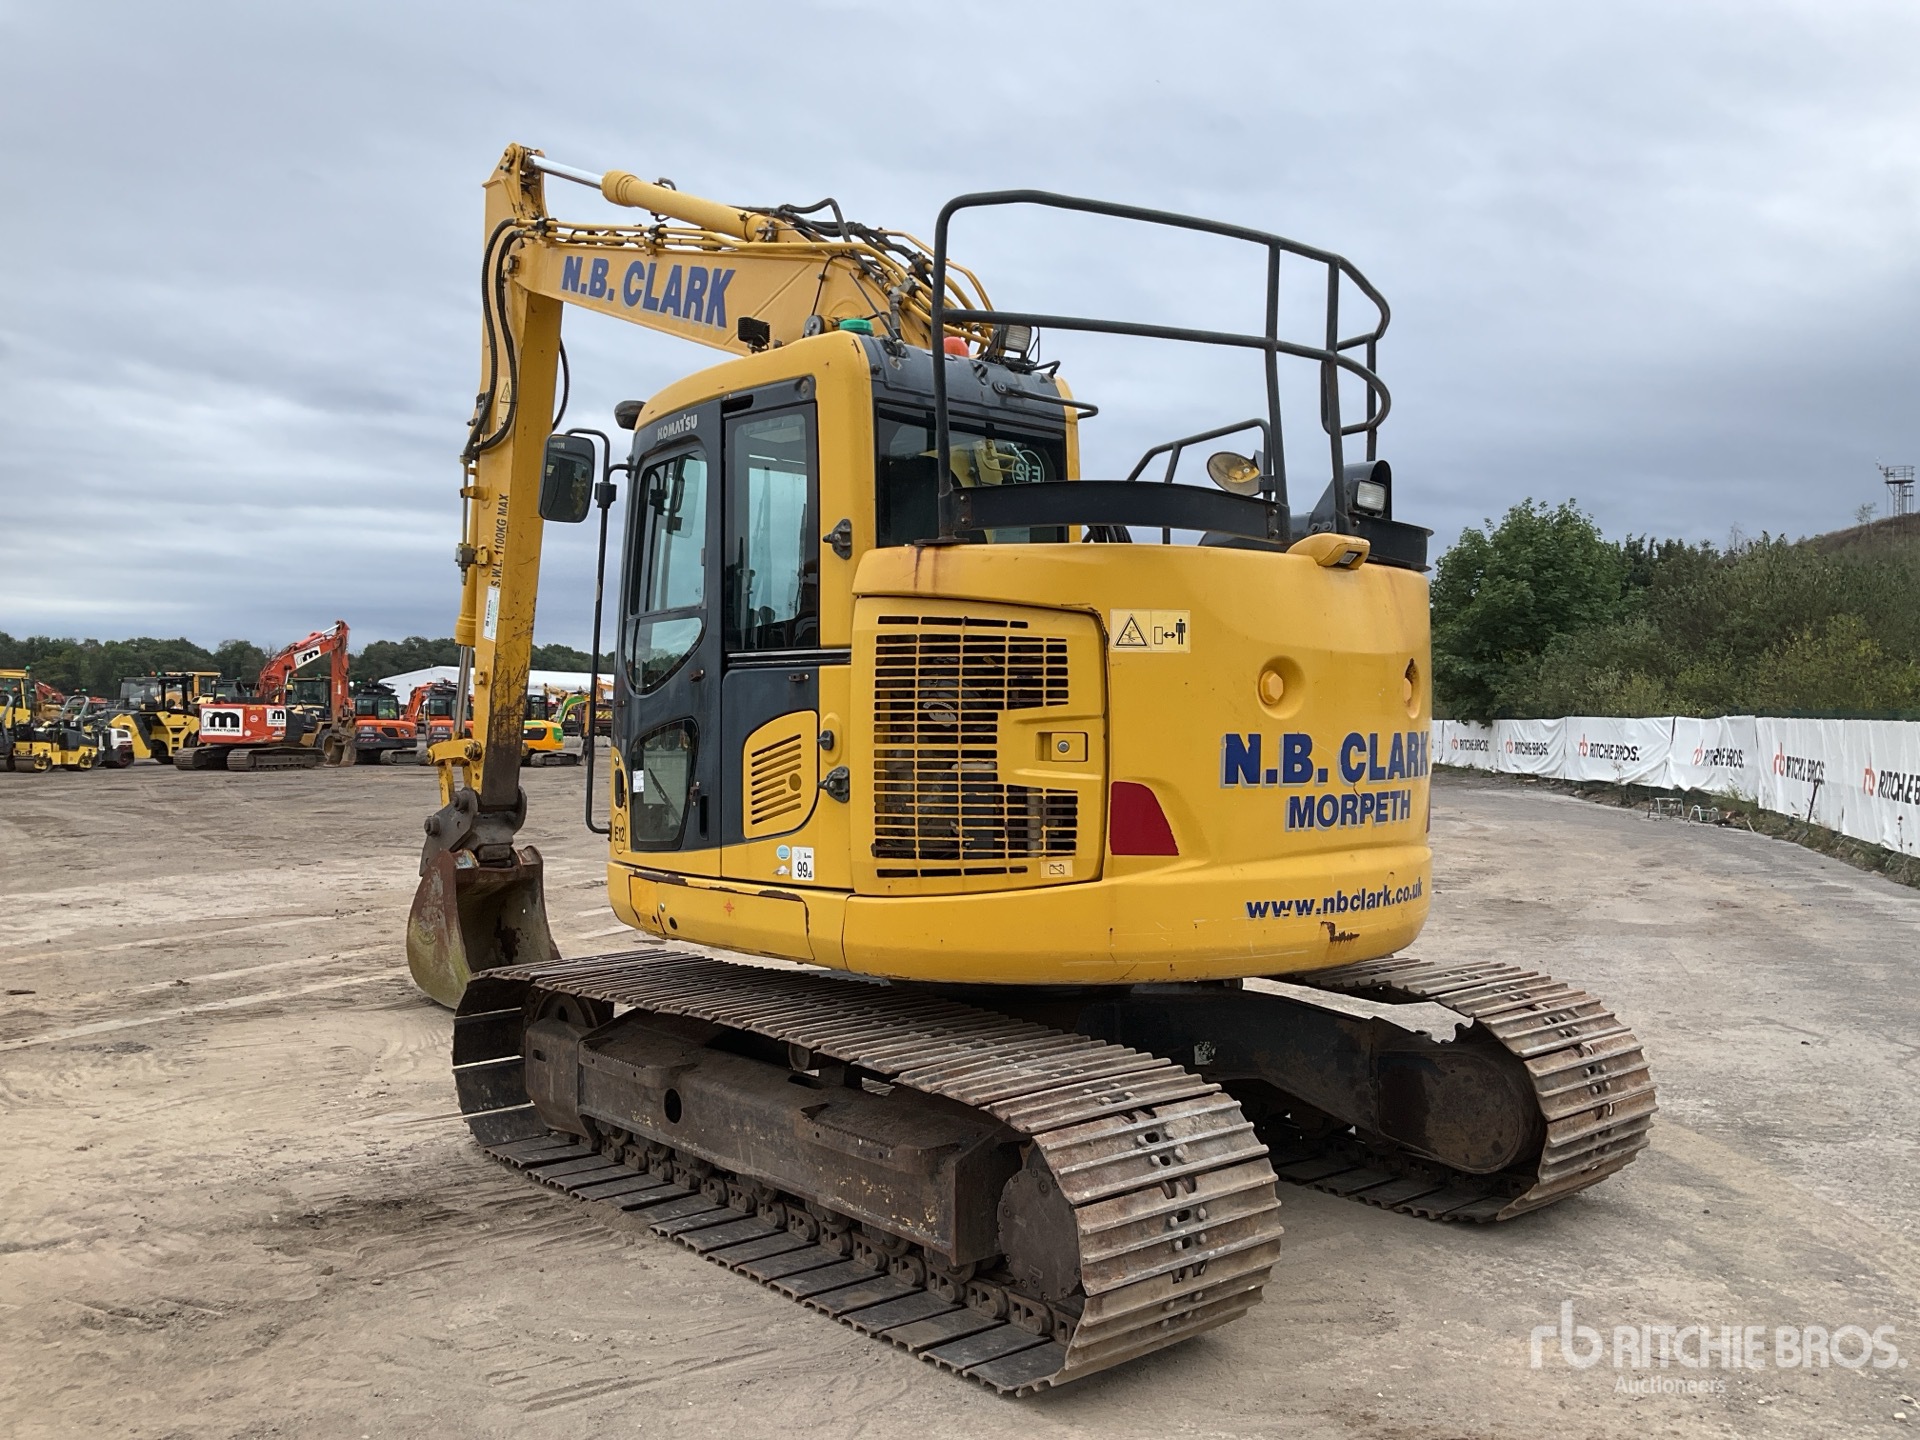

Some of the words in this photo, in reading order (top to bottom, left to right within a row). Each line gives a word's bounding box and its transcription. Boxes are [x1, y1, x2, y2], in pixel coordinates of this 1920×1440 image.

[561, 255, 615, 301] N.B.
[622, 260, 736, 329] CLARK
[657, 414, 697, 441] KOMATSU
[497, 493, 509, 516] MAX
[494, 518, 507, 555] 1100KG
[1221, 733, 1329, 788] N.B.
[1340, 731, 1430, 784] CLARK
[1589, 743, 1615, 760] RITCHIE
[1615, 744, 1640, 762] BROS.
[1286, 789, 1412, 831] MORPETH
[614, 826, 625, 842] E12
[797, 861, 808, 878] 99
[1246, 876, 1423, 919] www.nbclark.co.uk
